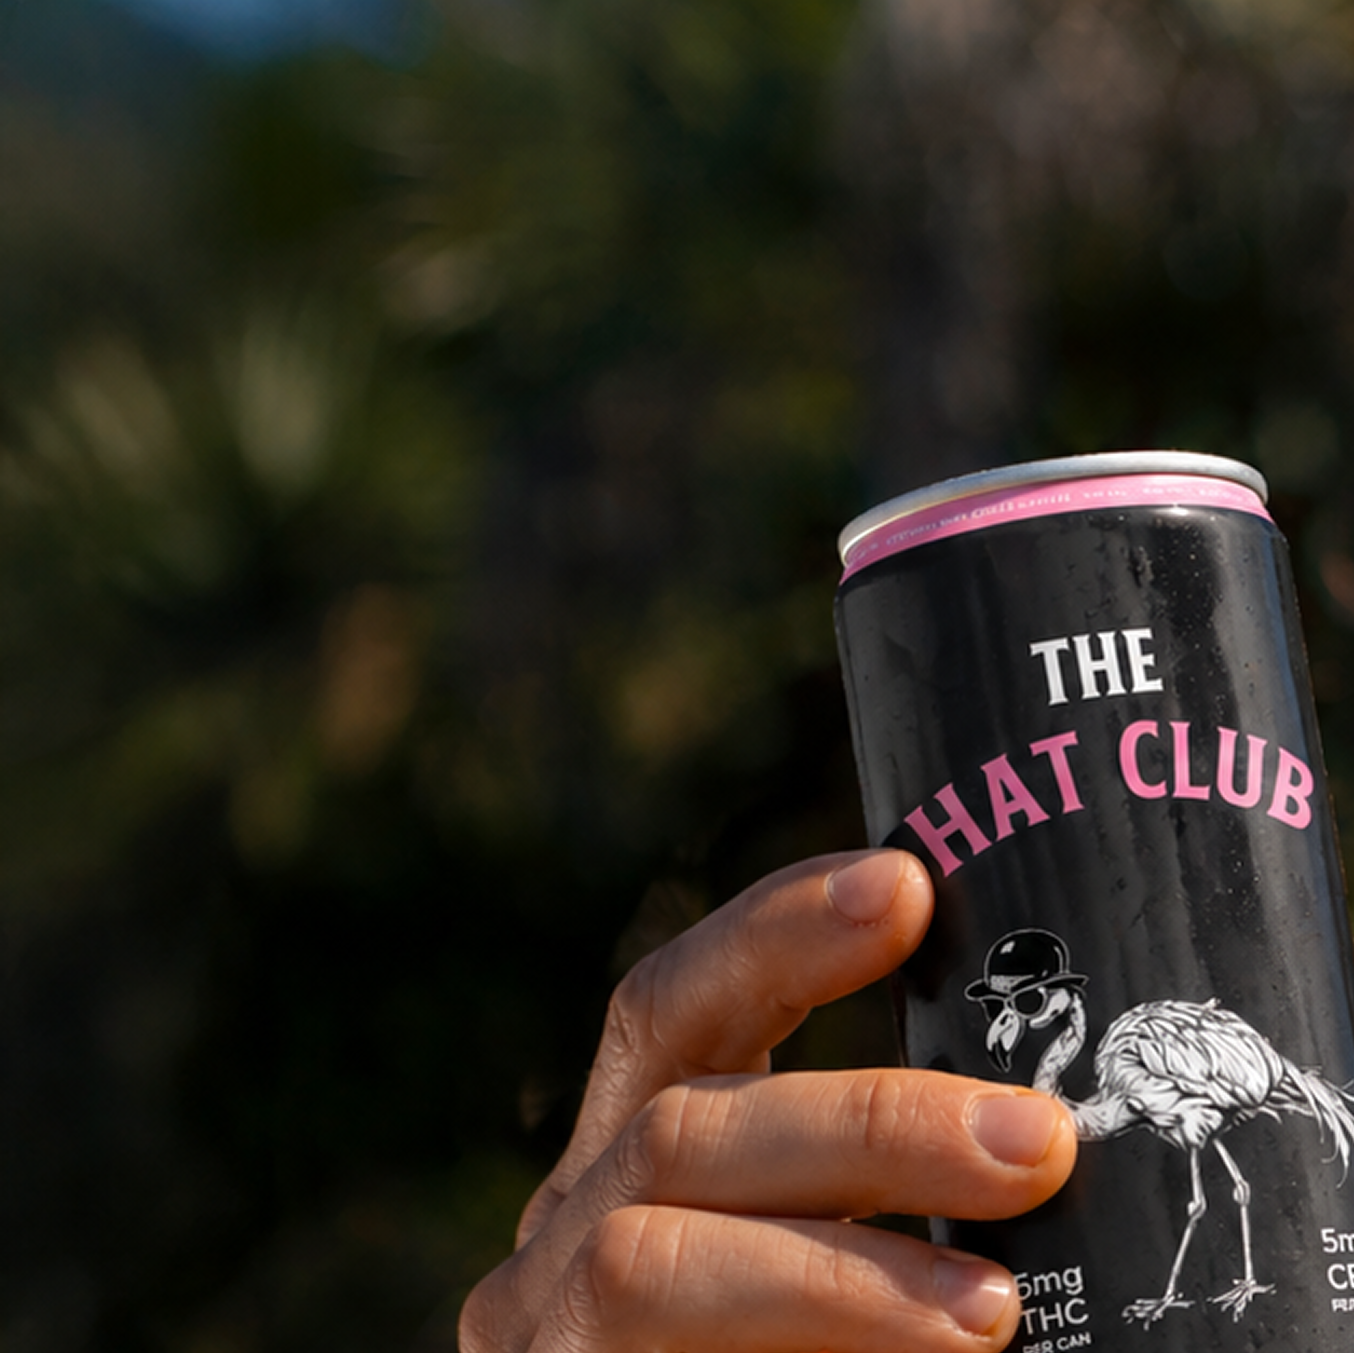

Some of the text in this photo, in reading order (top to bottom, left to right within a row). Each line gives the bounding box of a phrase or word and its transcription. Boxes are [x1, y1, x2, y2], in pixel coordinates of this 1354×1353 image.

[1030, 628, 1164, 706] THE
[904, 720, 1315, 878] HAT CLUB
[1020, 1297, 1089, 1335] THC
[1056, 1331, 1092, 1351] CAN
